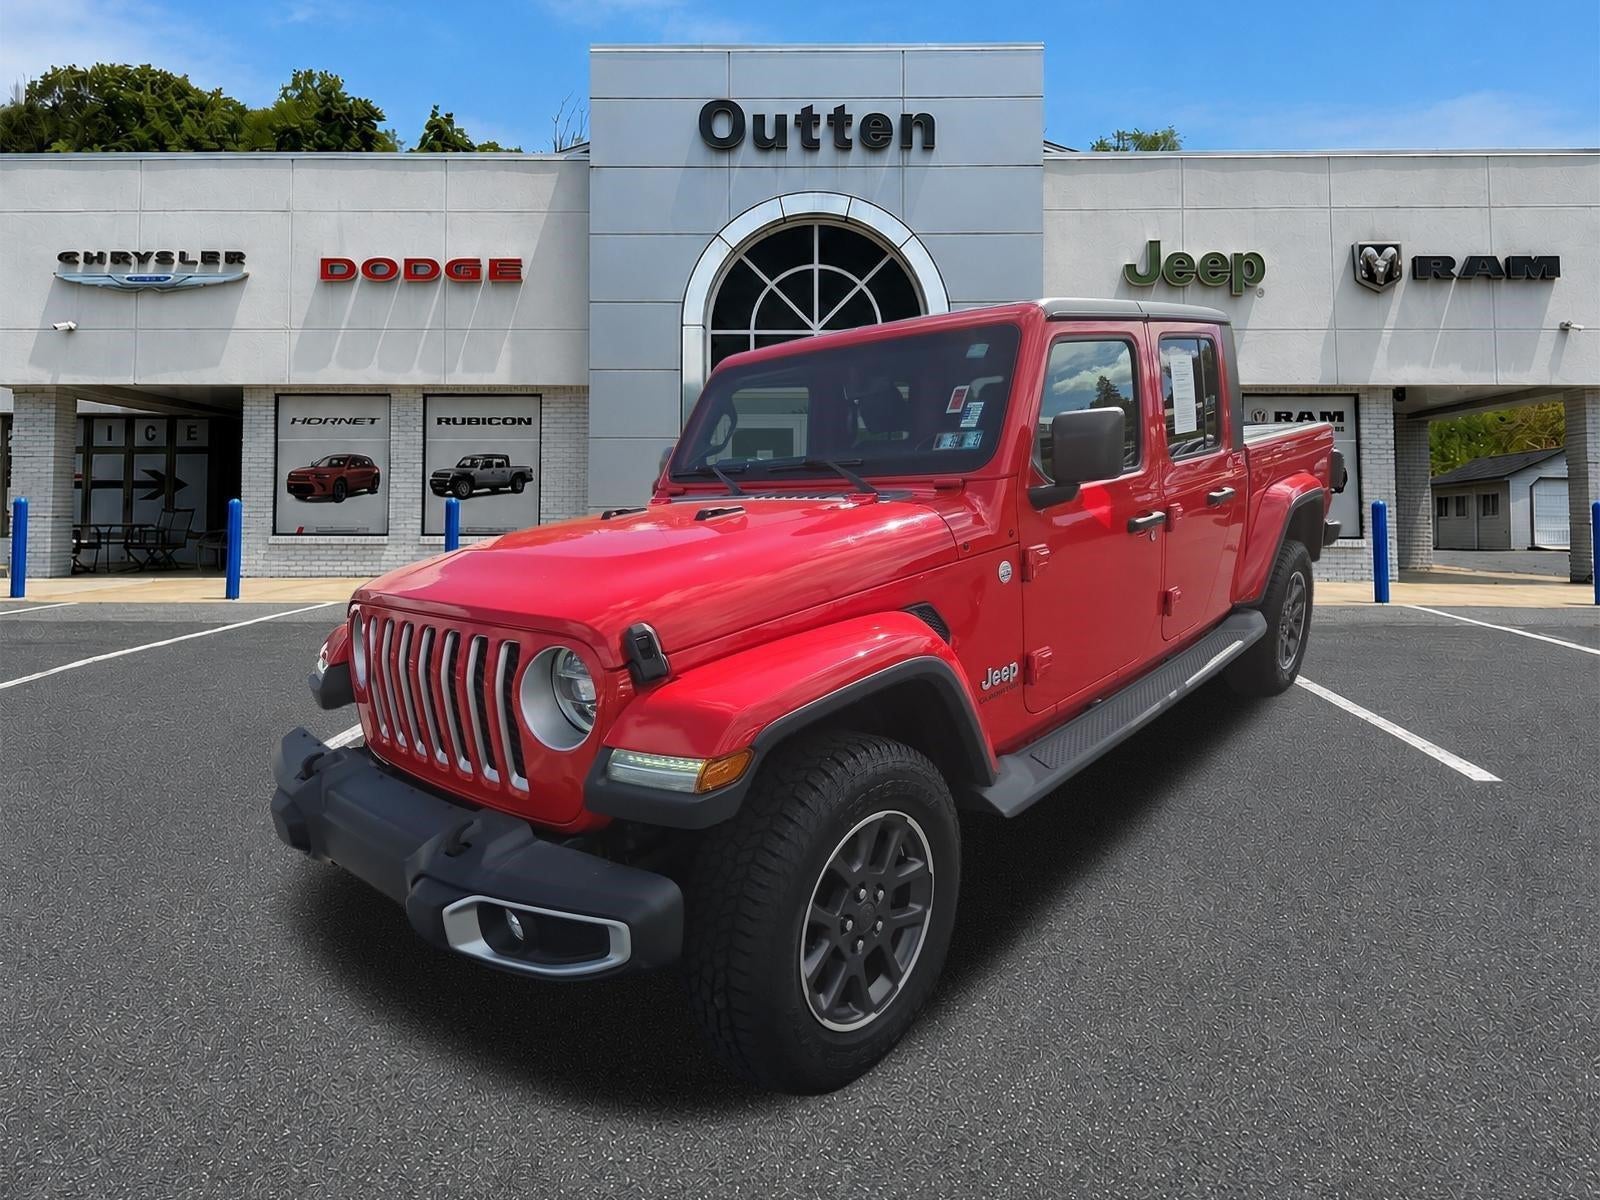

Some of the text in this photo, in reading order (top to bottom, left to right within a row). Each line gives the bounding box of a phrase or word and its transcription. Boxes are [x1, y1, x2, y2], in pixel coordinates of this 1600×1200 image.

[698, 99, 936, 150] Outten
[57, 250, 246, 266] CHRYSLER
[320, 256, 524, 283] DODGE
[1123, 239, 1266, 296] Jeep
[1411, 255, 1561, 281] RAM
[291, 417, 381, 426] HORNET
[436, 416, 532, 426] RUBICON
[1274, 411, 1344, 423] RAM
[980, 661, 1020, 691] Jeep
